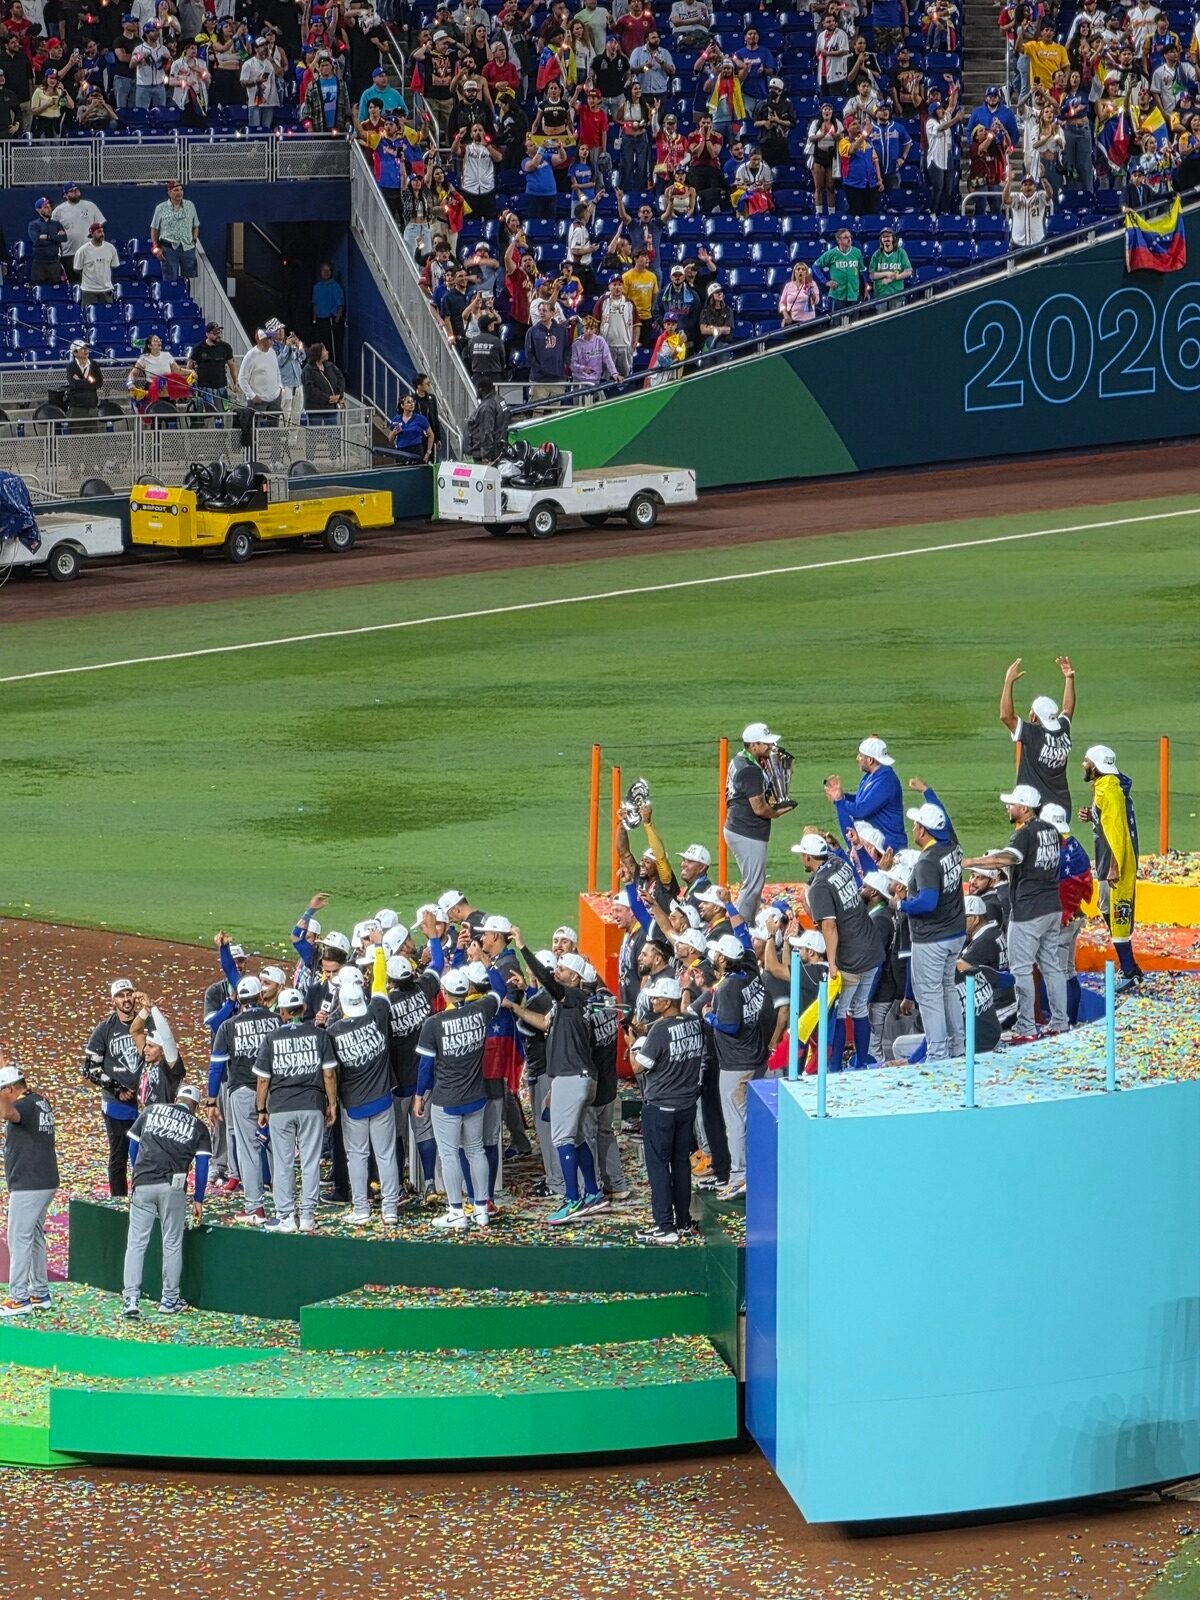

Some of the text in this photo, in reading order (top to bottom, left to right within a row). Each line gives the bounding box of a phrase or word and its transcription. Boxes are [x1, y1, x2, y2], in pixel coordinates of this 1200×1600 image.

[1031, 207, 1040, 218] 21
[836, 260, 848, 269] RED
[878, 262, 902, 271] RED SOX
[473, 342, 494, 350] BEST
[964, 281, 1200, 412] 2026
[142, 504, 167, 512] BIGFOOT
[390, 990, 428, 1020] THE BEST
[234, 1017, 280, 1037] THE BEST
[442, 1018, 463, 1035] THE
[463, 1012, 485, 1031] BEST
[667, 1024, 684, 1041] THE
[234, 1033, 266, 1052] BASE
[272, 1038, 293, 1055] THE
[292, 1034, 318, 1052] BEST
[334, 1031, 356, 1050] THE
[353, 1020, 377, 1043] BEST
[442, 1026, 487, 1051] BASEBALL
[337, 1031, 385, 1062] BASEBALL
[272, 1050, 320, 1070] BASEBALL
[284, 1062, 320, 1077] World
[152, 1104, 198, 1126] THE BEST
[145, 1113, 195, 1138] BASEBALL
[152, 1128, 192, 1144] World
